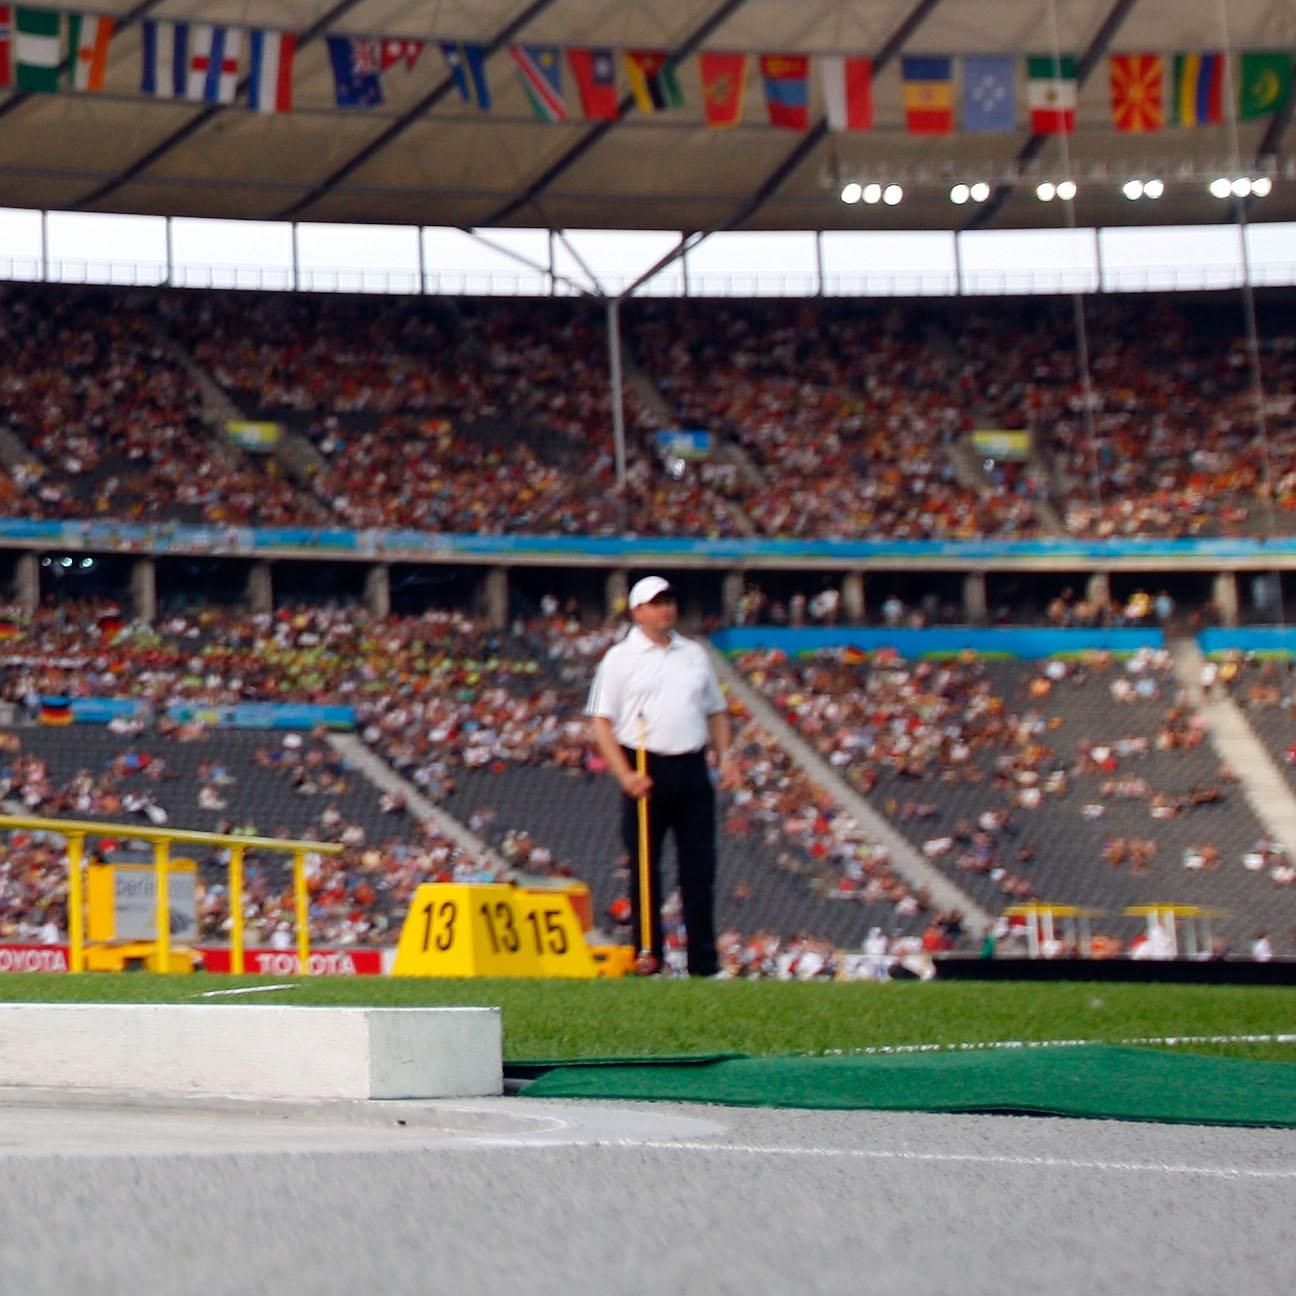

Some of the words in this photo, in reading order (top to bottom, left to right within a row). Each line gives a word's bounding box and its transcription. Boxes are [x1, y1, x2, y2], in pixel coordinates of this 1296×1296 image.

[420, 901, 459, 953] 13
[480, 901, 520, 954] 13
[525, 909, 570, 955] 15
[254, 952, 358, 976] TOOTA
